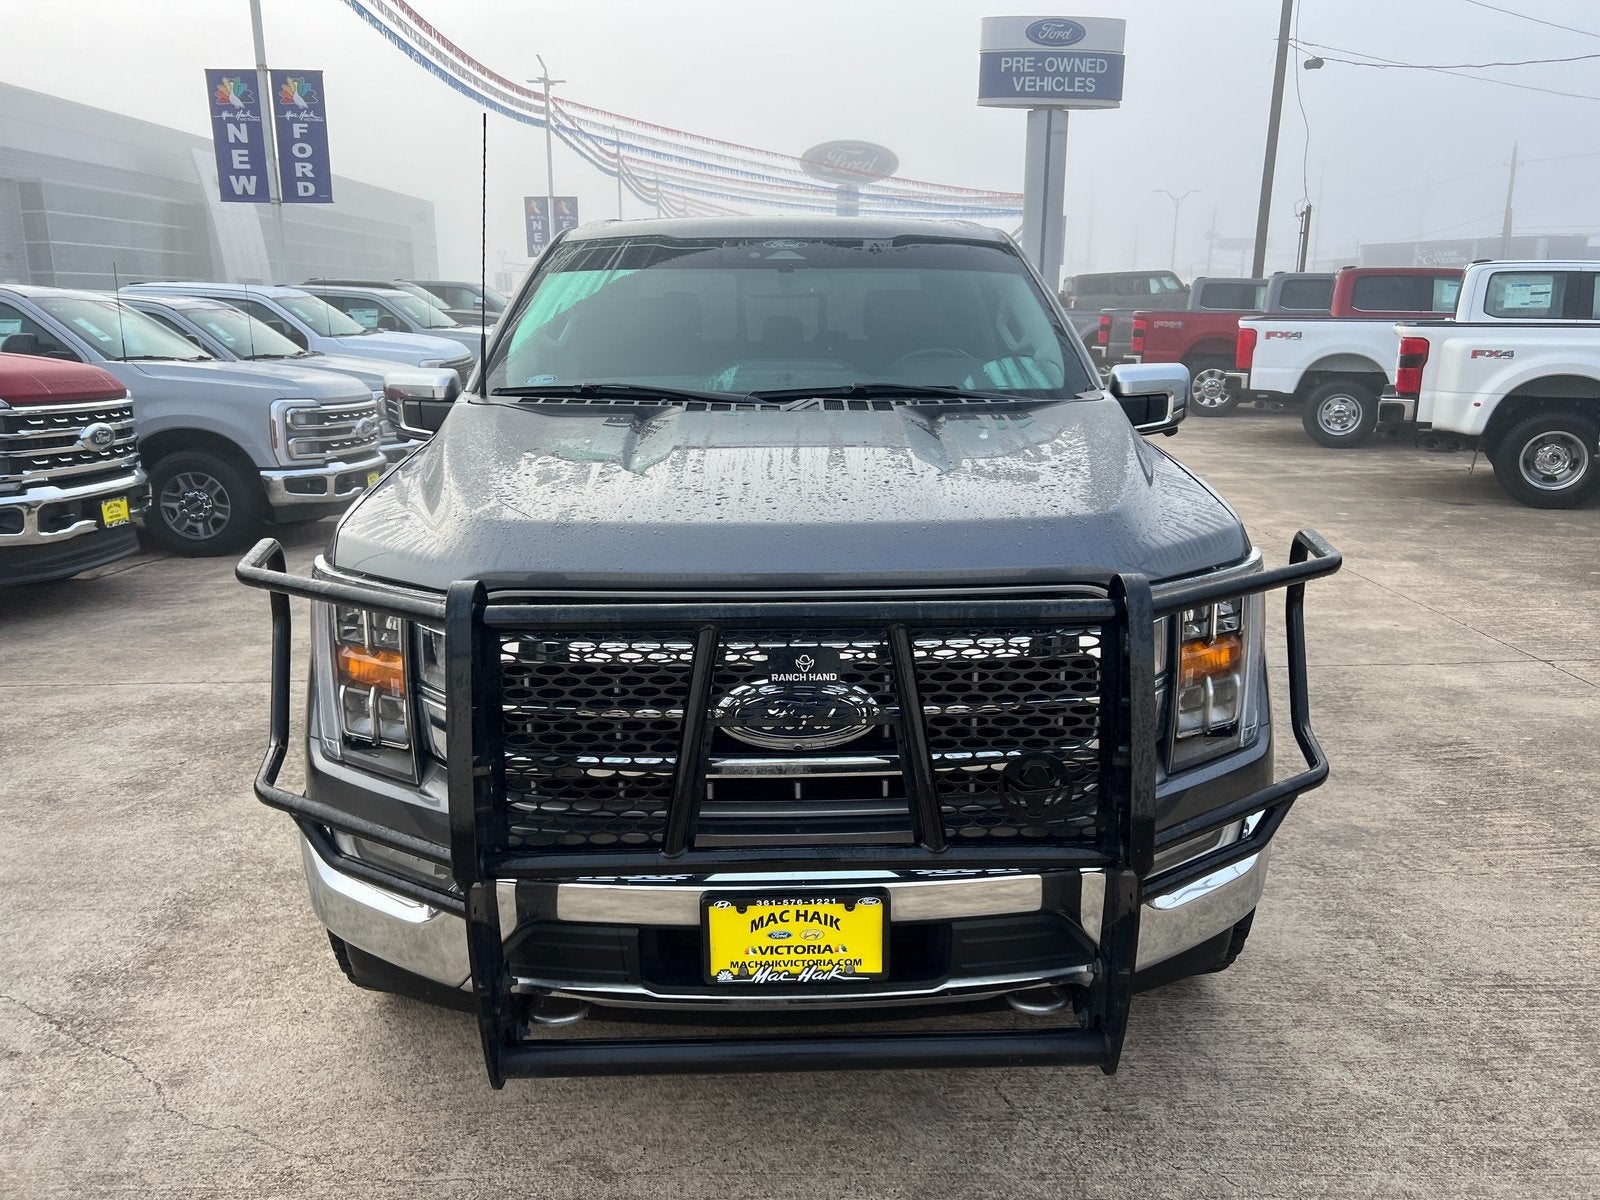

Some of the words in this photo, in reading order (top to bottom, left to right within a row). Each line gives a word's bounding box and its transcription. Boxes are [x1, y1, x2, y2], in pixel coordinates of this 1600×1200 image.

[1038, 22, 1073, 40] Ford
[1013, 76, 1096, 93] VEHICLES
[226, 123, 257, 196] NEW
[291, 123, 317, 197] FORD
[824, 148, 879, 173] Ford
[532, 220, 545, 255] NEW
[1265, 331, 1302, 339] FX4
[1471, 349, 1515, 359] FX4
[95, 430, 111, 444] Ford
[771, 673, 807, 682] RANCH
[808, 673, 837, 681] HAND
[750, 910, 790, 933] MAC
[795, 909, 841, 931] HAIK
[769, 931, 790, 940] Ford
[758, 944, 834, 956] VICTORIA
[750, 966, 796, 984] Mac
[797, 965, 844, 983] Haik
